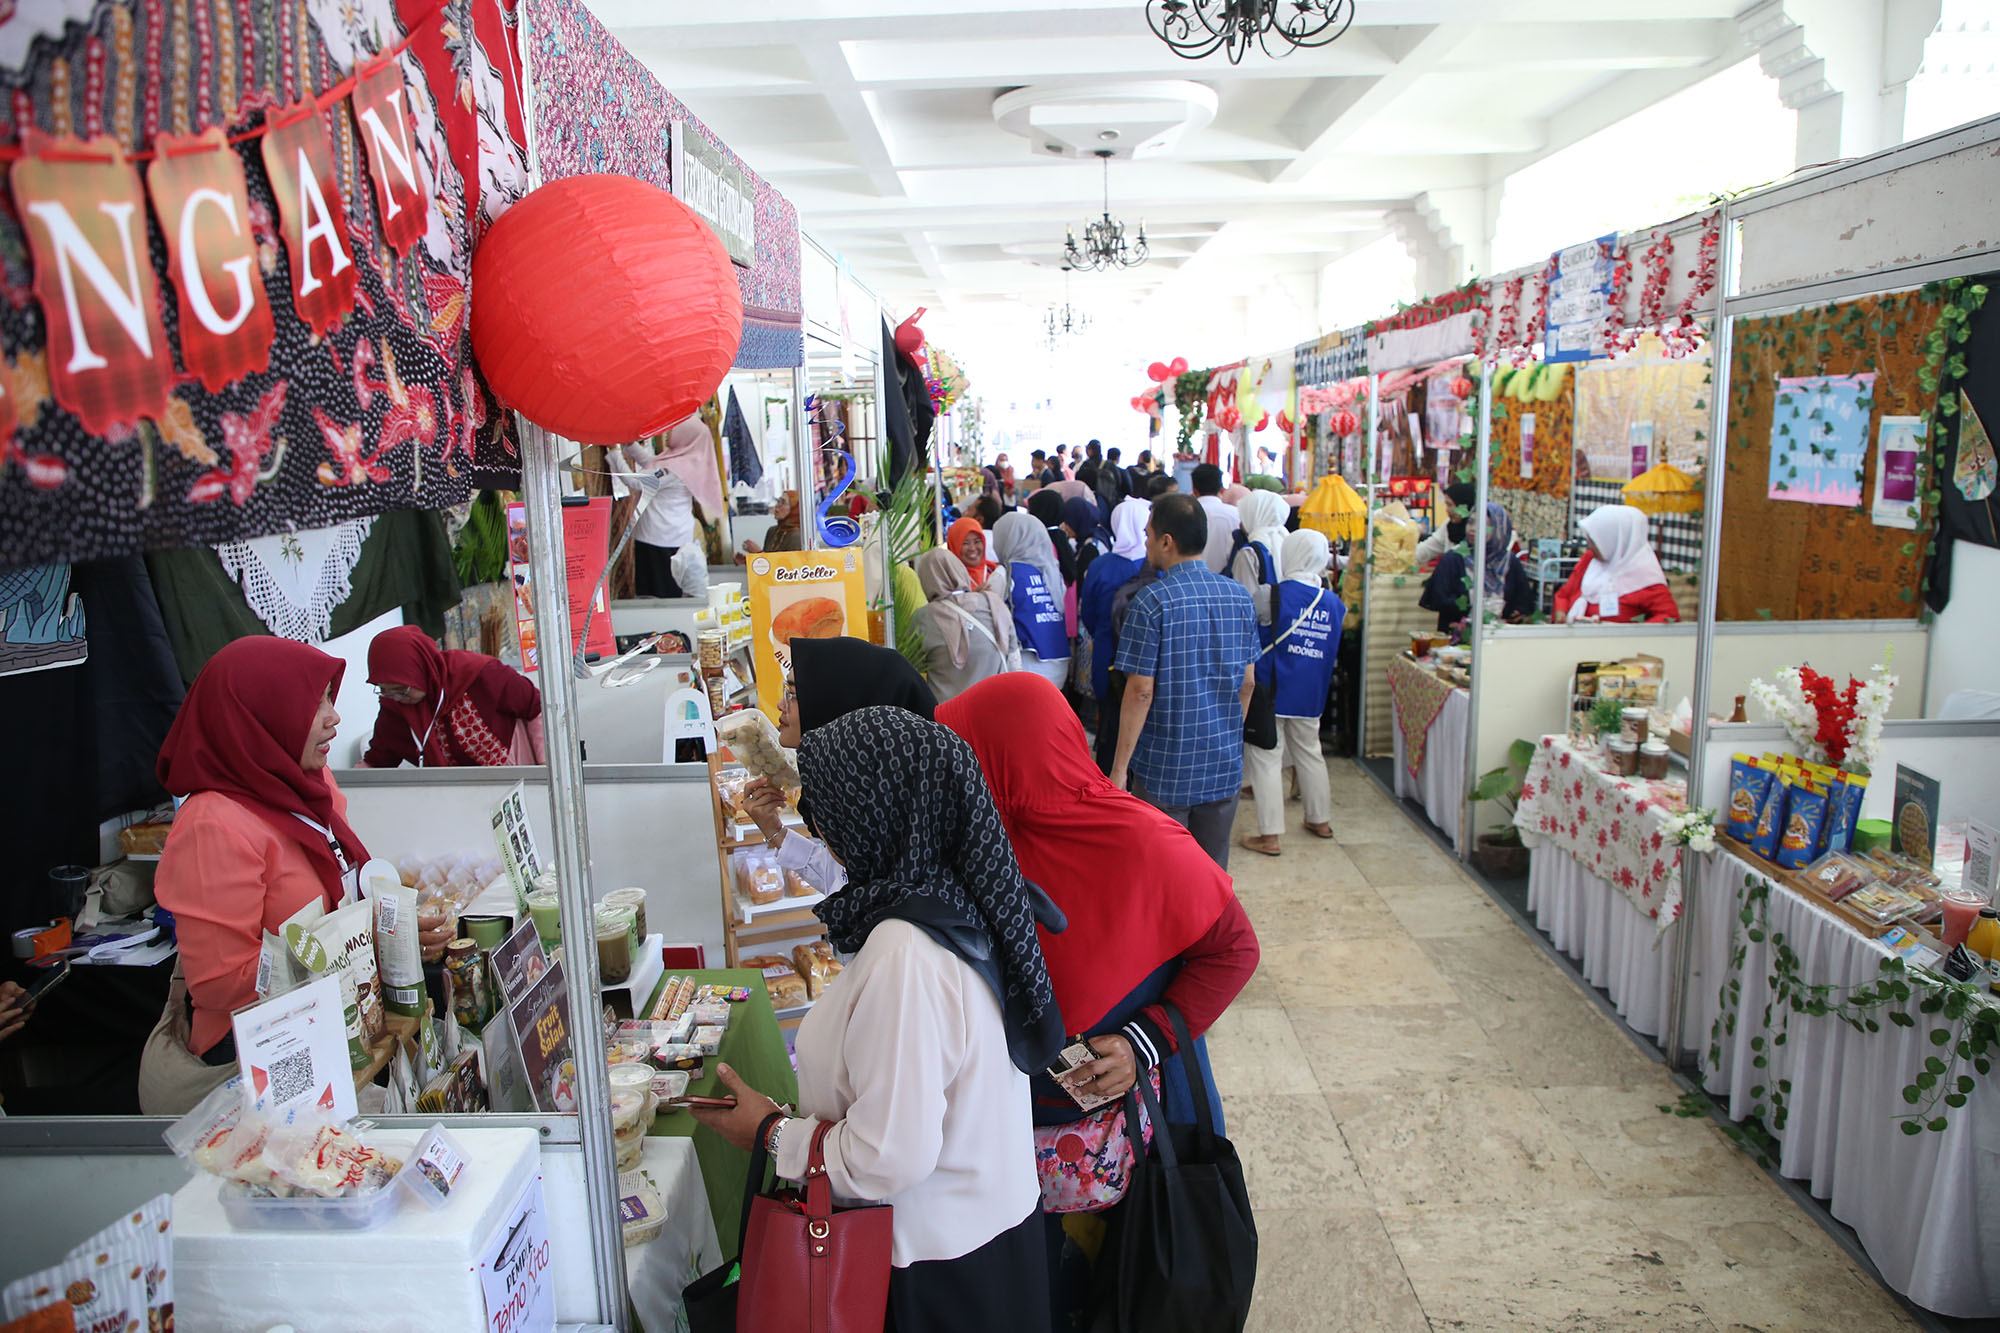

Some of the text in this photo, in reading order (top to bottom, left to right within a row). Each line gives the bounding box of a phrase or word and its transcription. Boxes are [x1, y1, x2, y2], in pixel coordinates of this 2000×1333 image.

[0, 89, 419, 398] NGAN
[776, 567, 836, 581] Best Seller
[1029, 574, 1042, 586] IW
[775, 650, 793, 671] BLU
[1288, 644, 1324, 659] INDONESIA
[536, 1004, 560, 1040] Fruit
[540, 1019, 565, 1058] Salad
